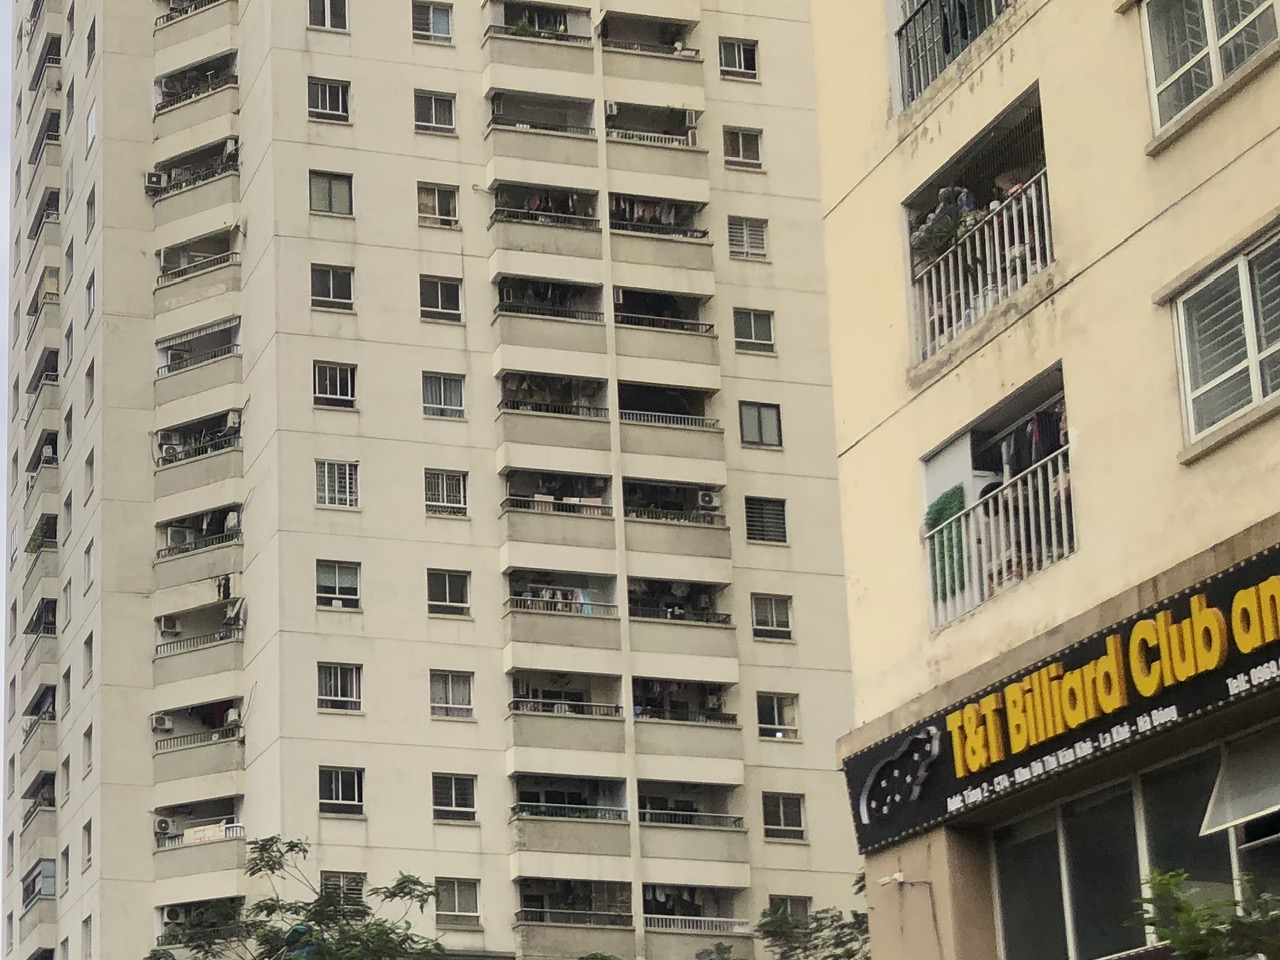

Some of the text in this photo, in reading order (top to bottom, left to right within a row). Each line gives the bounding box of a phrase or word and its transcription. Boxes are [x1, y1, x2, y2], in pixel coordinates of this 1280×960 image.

[946, 693, 1006, 779] T&T
[1004, 634, 1128, 755] Billiard
[1129, 594, 1227, 697] Club
[981, 782, 990, 796] 2
